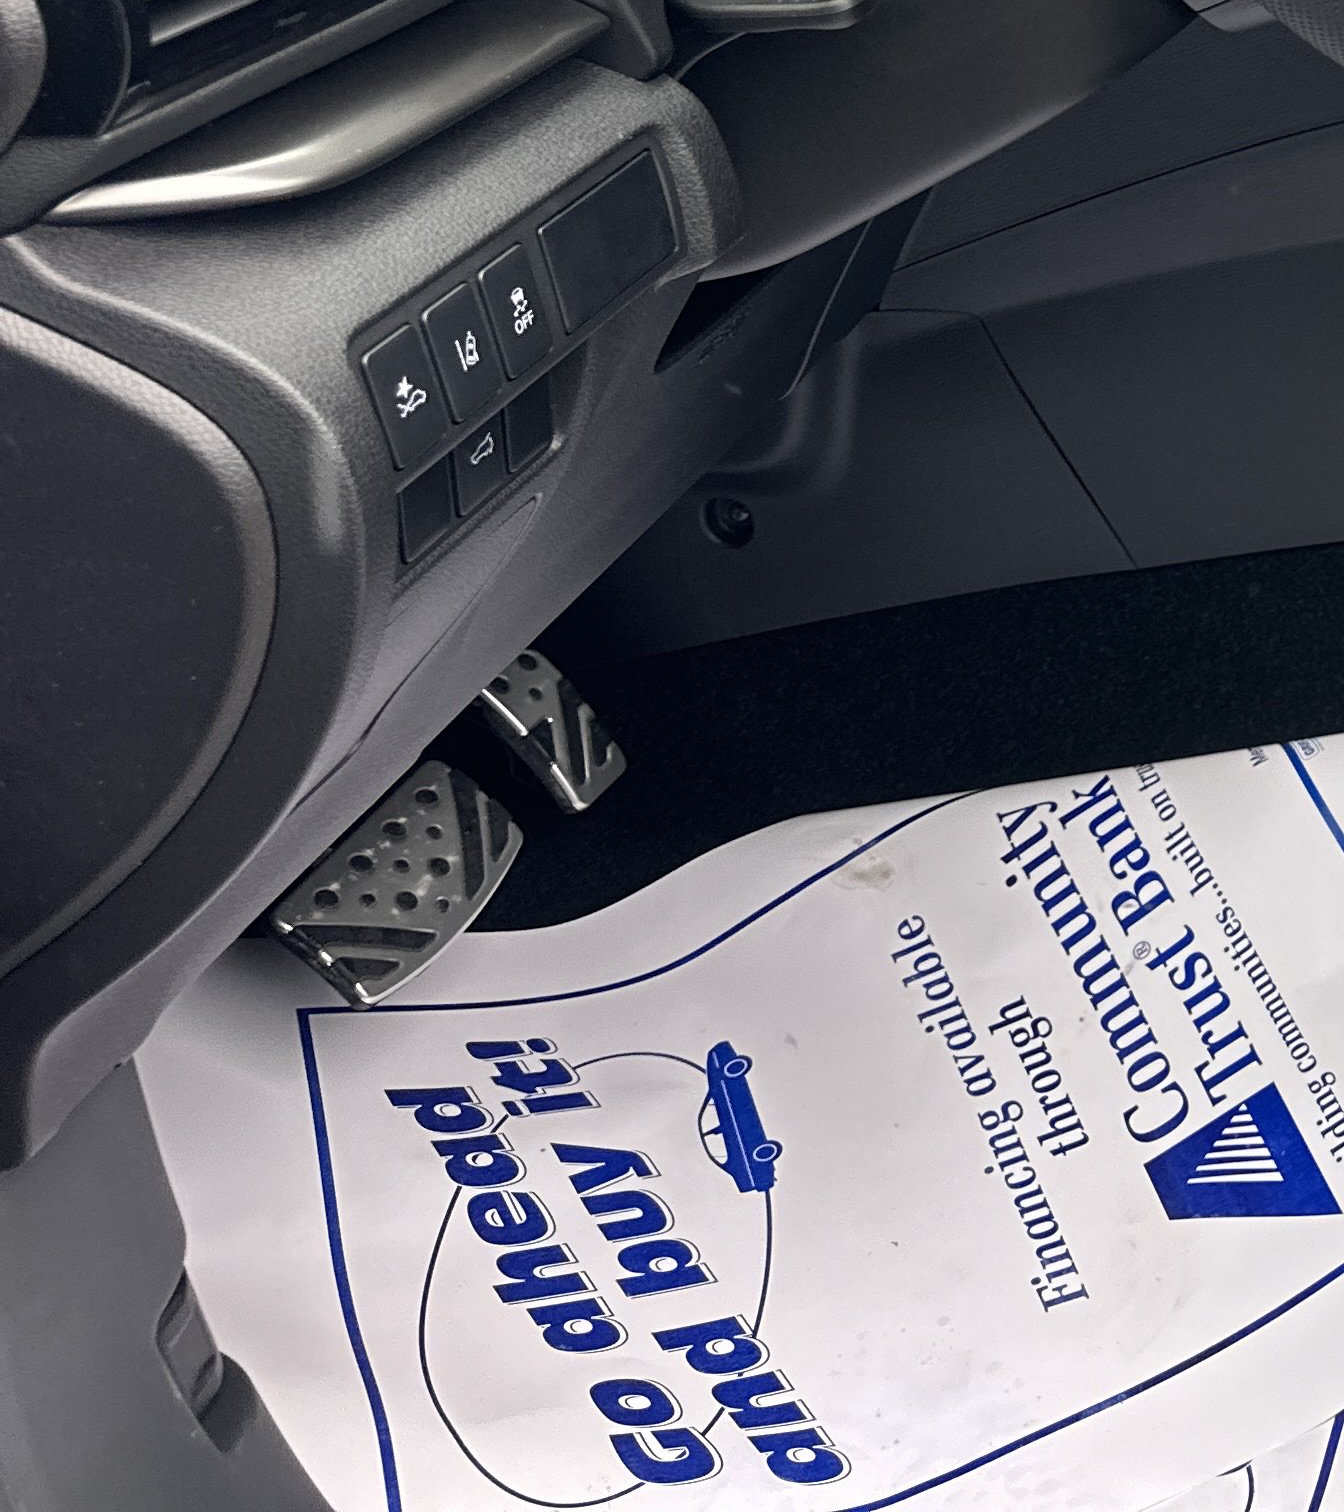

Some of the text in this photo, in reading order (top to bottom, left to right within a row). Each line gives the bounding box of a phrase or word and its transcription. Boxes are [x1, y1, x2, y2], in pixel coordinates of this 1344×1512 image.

[514, 310, 534, 334] OFF
[1058, 774, 1175, 937] Bank
[1151, 788, 1178, 822] on
[988, 995, 1090, 1157] through
[996, 799, 1190, 1143] Community
[890, 914, 1089, 1312] Financing available
[385, 1086, 724, 1486] Go ahead
[466, 1037, 851, 1485] and buy it!
